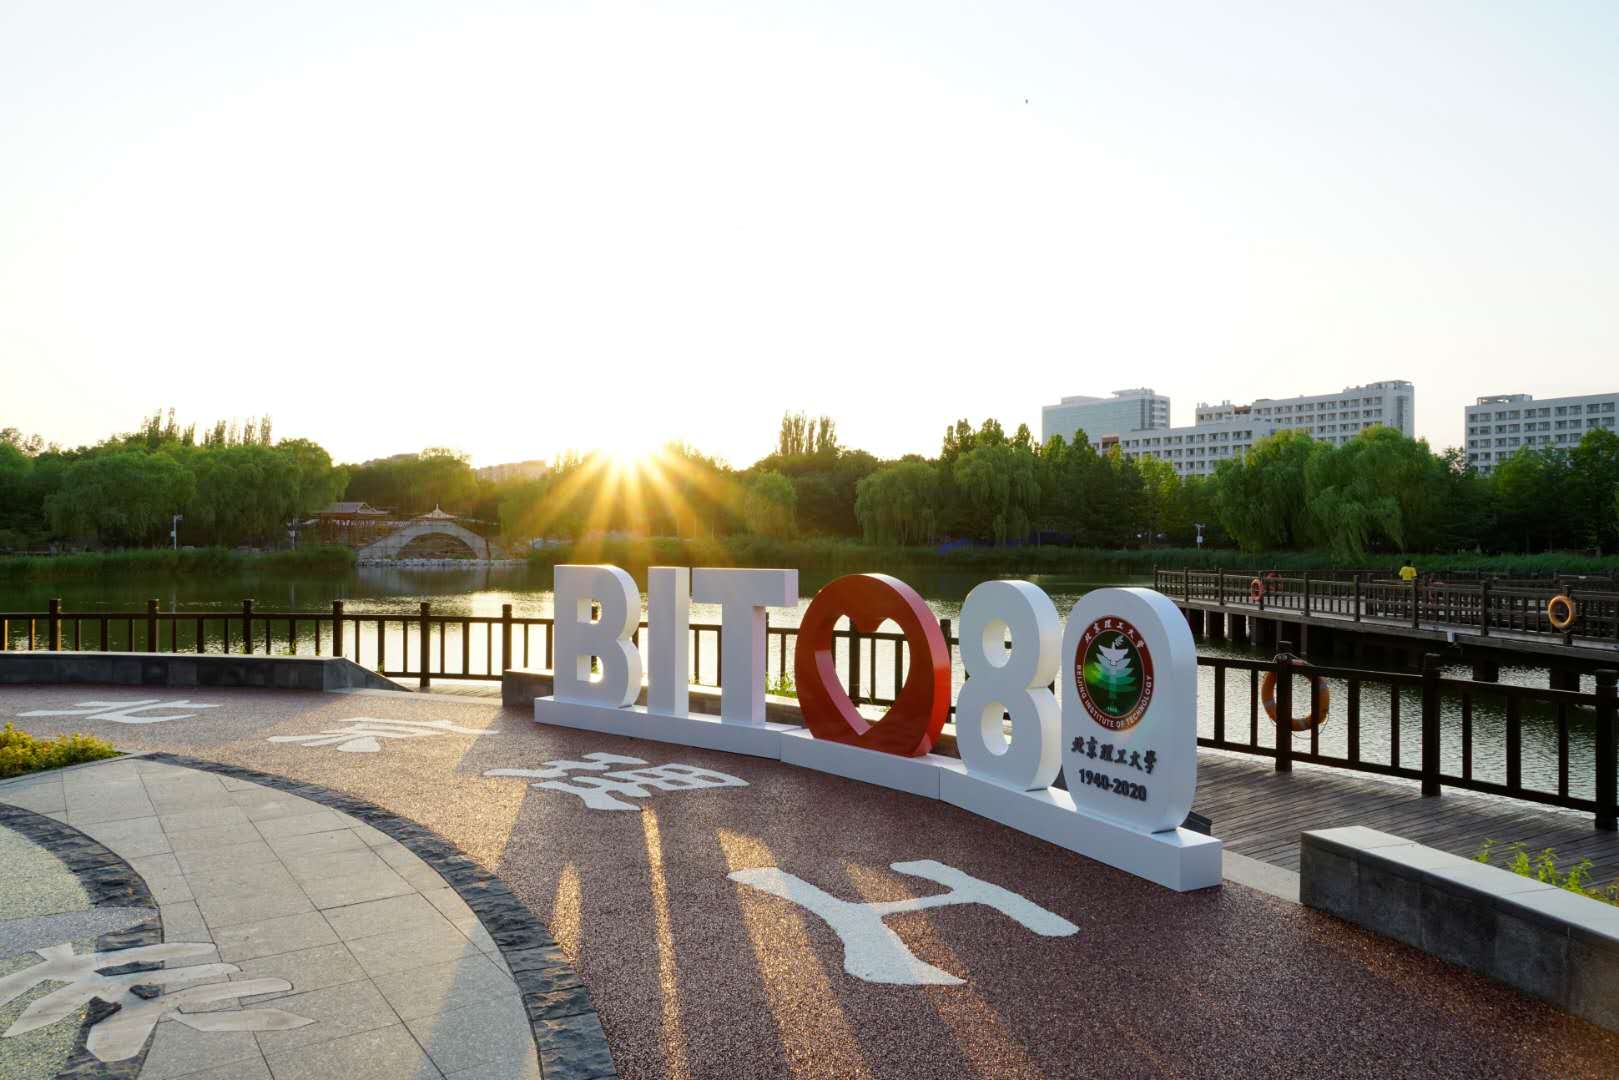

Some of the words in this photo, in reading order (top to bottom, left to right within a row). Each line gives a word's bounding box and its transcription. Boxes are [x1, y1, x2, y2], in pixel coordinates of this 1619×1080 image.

[555, 564, 798, 729] BIT
[1076, 664, 1087, 699] BEIJING
[1085, 700, 1115, 728] INSTITUTE
[1126, 675, 1153, 725] TECHNOLOGY
[1079, 768, 1147, 801] 1940-2020
